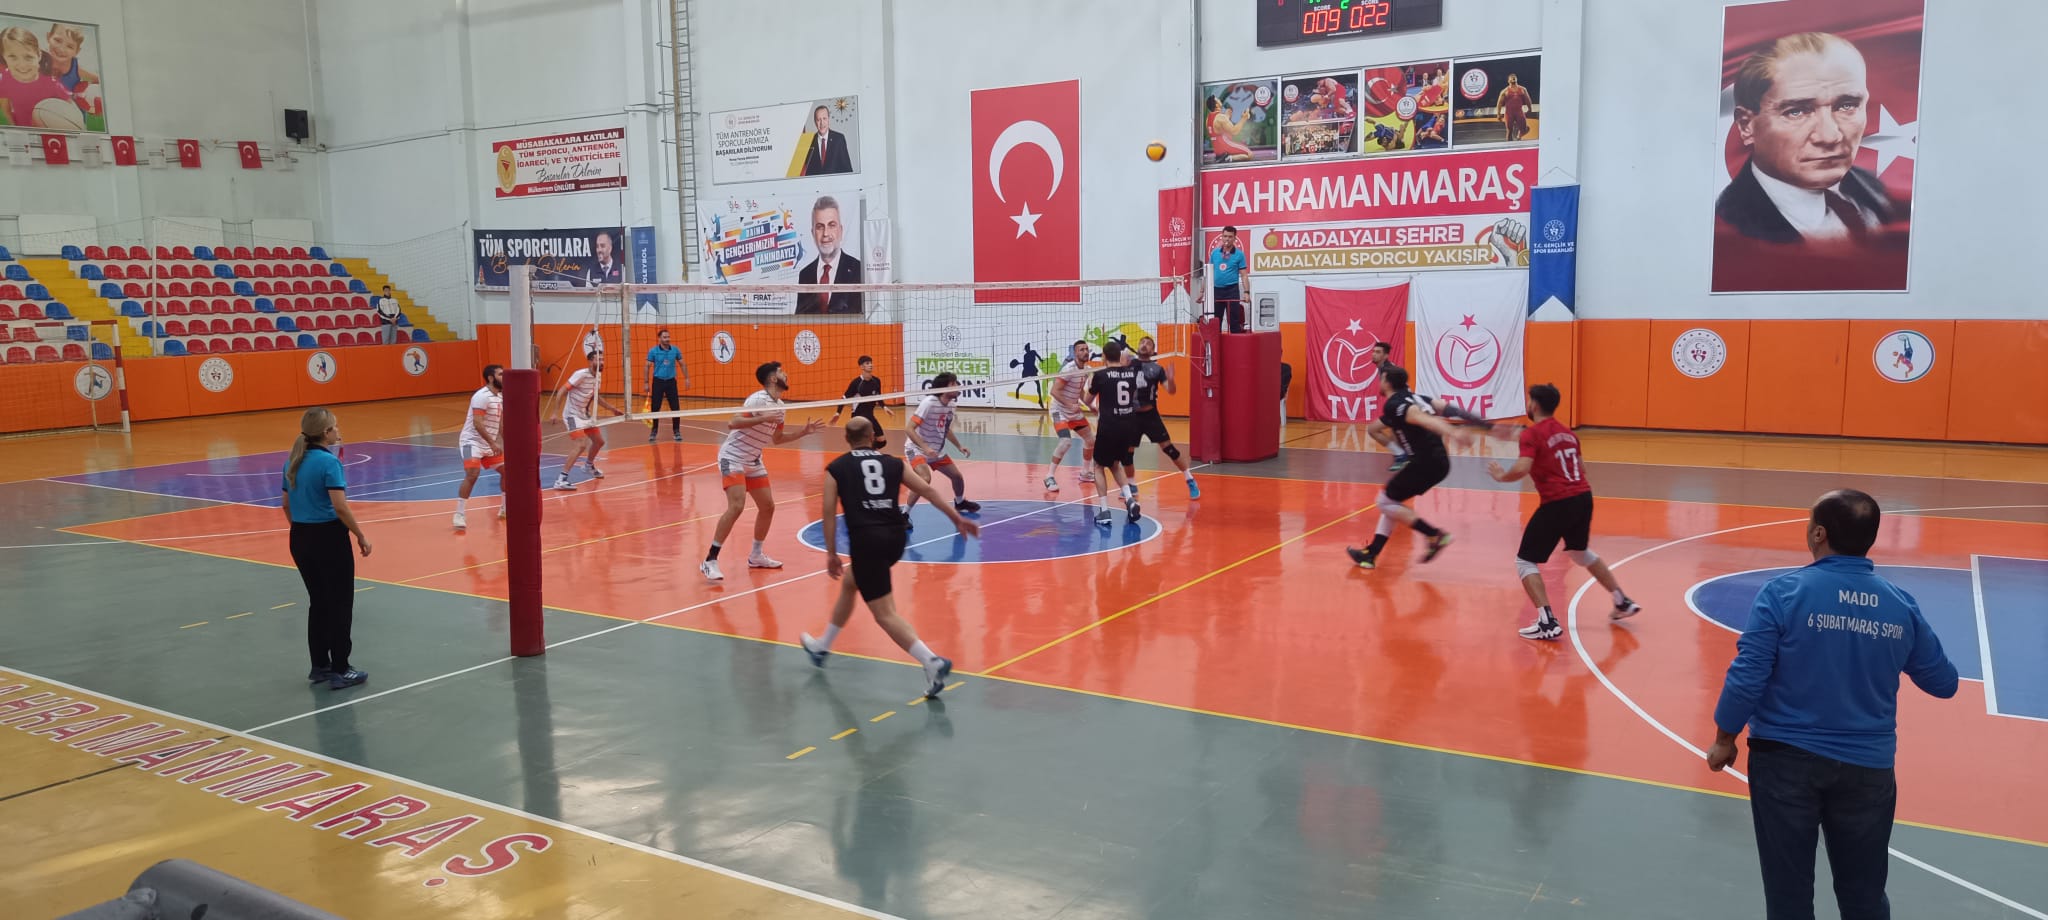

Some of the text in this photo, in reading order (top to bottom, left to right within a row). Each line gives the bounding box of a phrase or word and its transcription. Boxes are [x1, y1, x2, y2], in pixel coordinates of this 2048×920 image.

[1303, 3, 1389, 34] 009 022
[516, 131, 619, 149] MÜSABAKALARA KATILAN
[718, 136, 769, 148] SPORCULARIMIZA
[762, 127, 771, 135] VE
[536, 147, 570, 157] SPORCU,
[572, 142, 618, 153] ANTRENÖR,
[563, 151, 621, 163] YÖNETİCİLERE
[1212, 164, 1525, 215] KAHRAMANMARAŞ
[479, 234, 592, 258] TÜM SPORCULARA
[1283, 225, 1461, 248] MADALYALI ŞEHRE
[1257, 247, 1489, 269] MADALYALI SPORCU YAKIŞIR
[918, 360, 989, 374] HAREKETE
[1117, 381, 1130, 406] 6
[1327, 395, 1378, 421] TVF
[1555, 448, 1581, 481] 17
[861, 459, 886, 495] 8
[1839, 589, 1879, 607] MADO
[1807, 613, 1904, 640] 6 ŞUBAT MARAŞ SPOR
